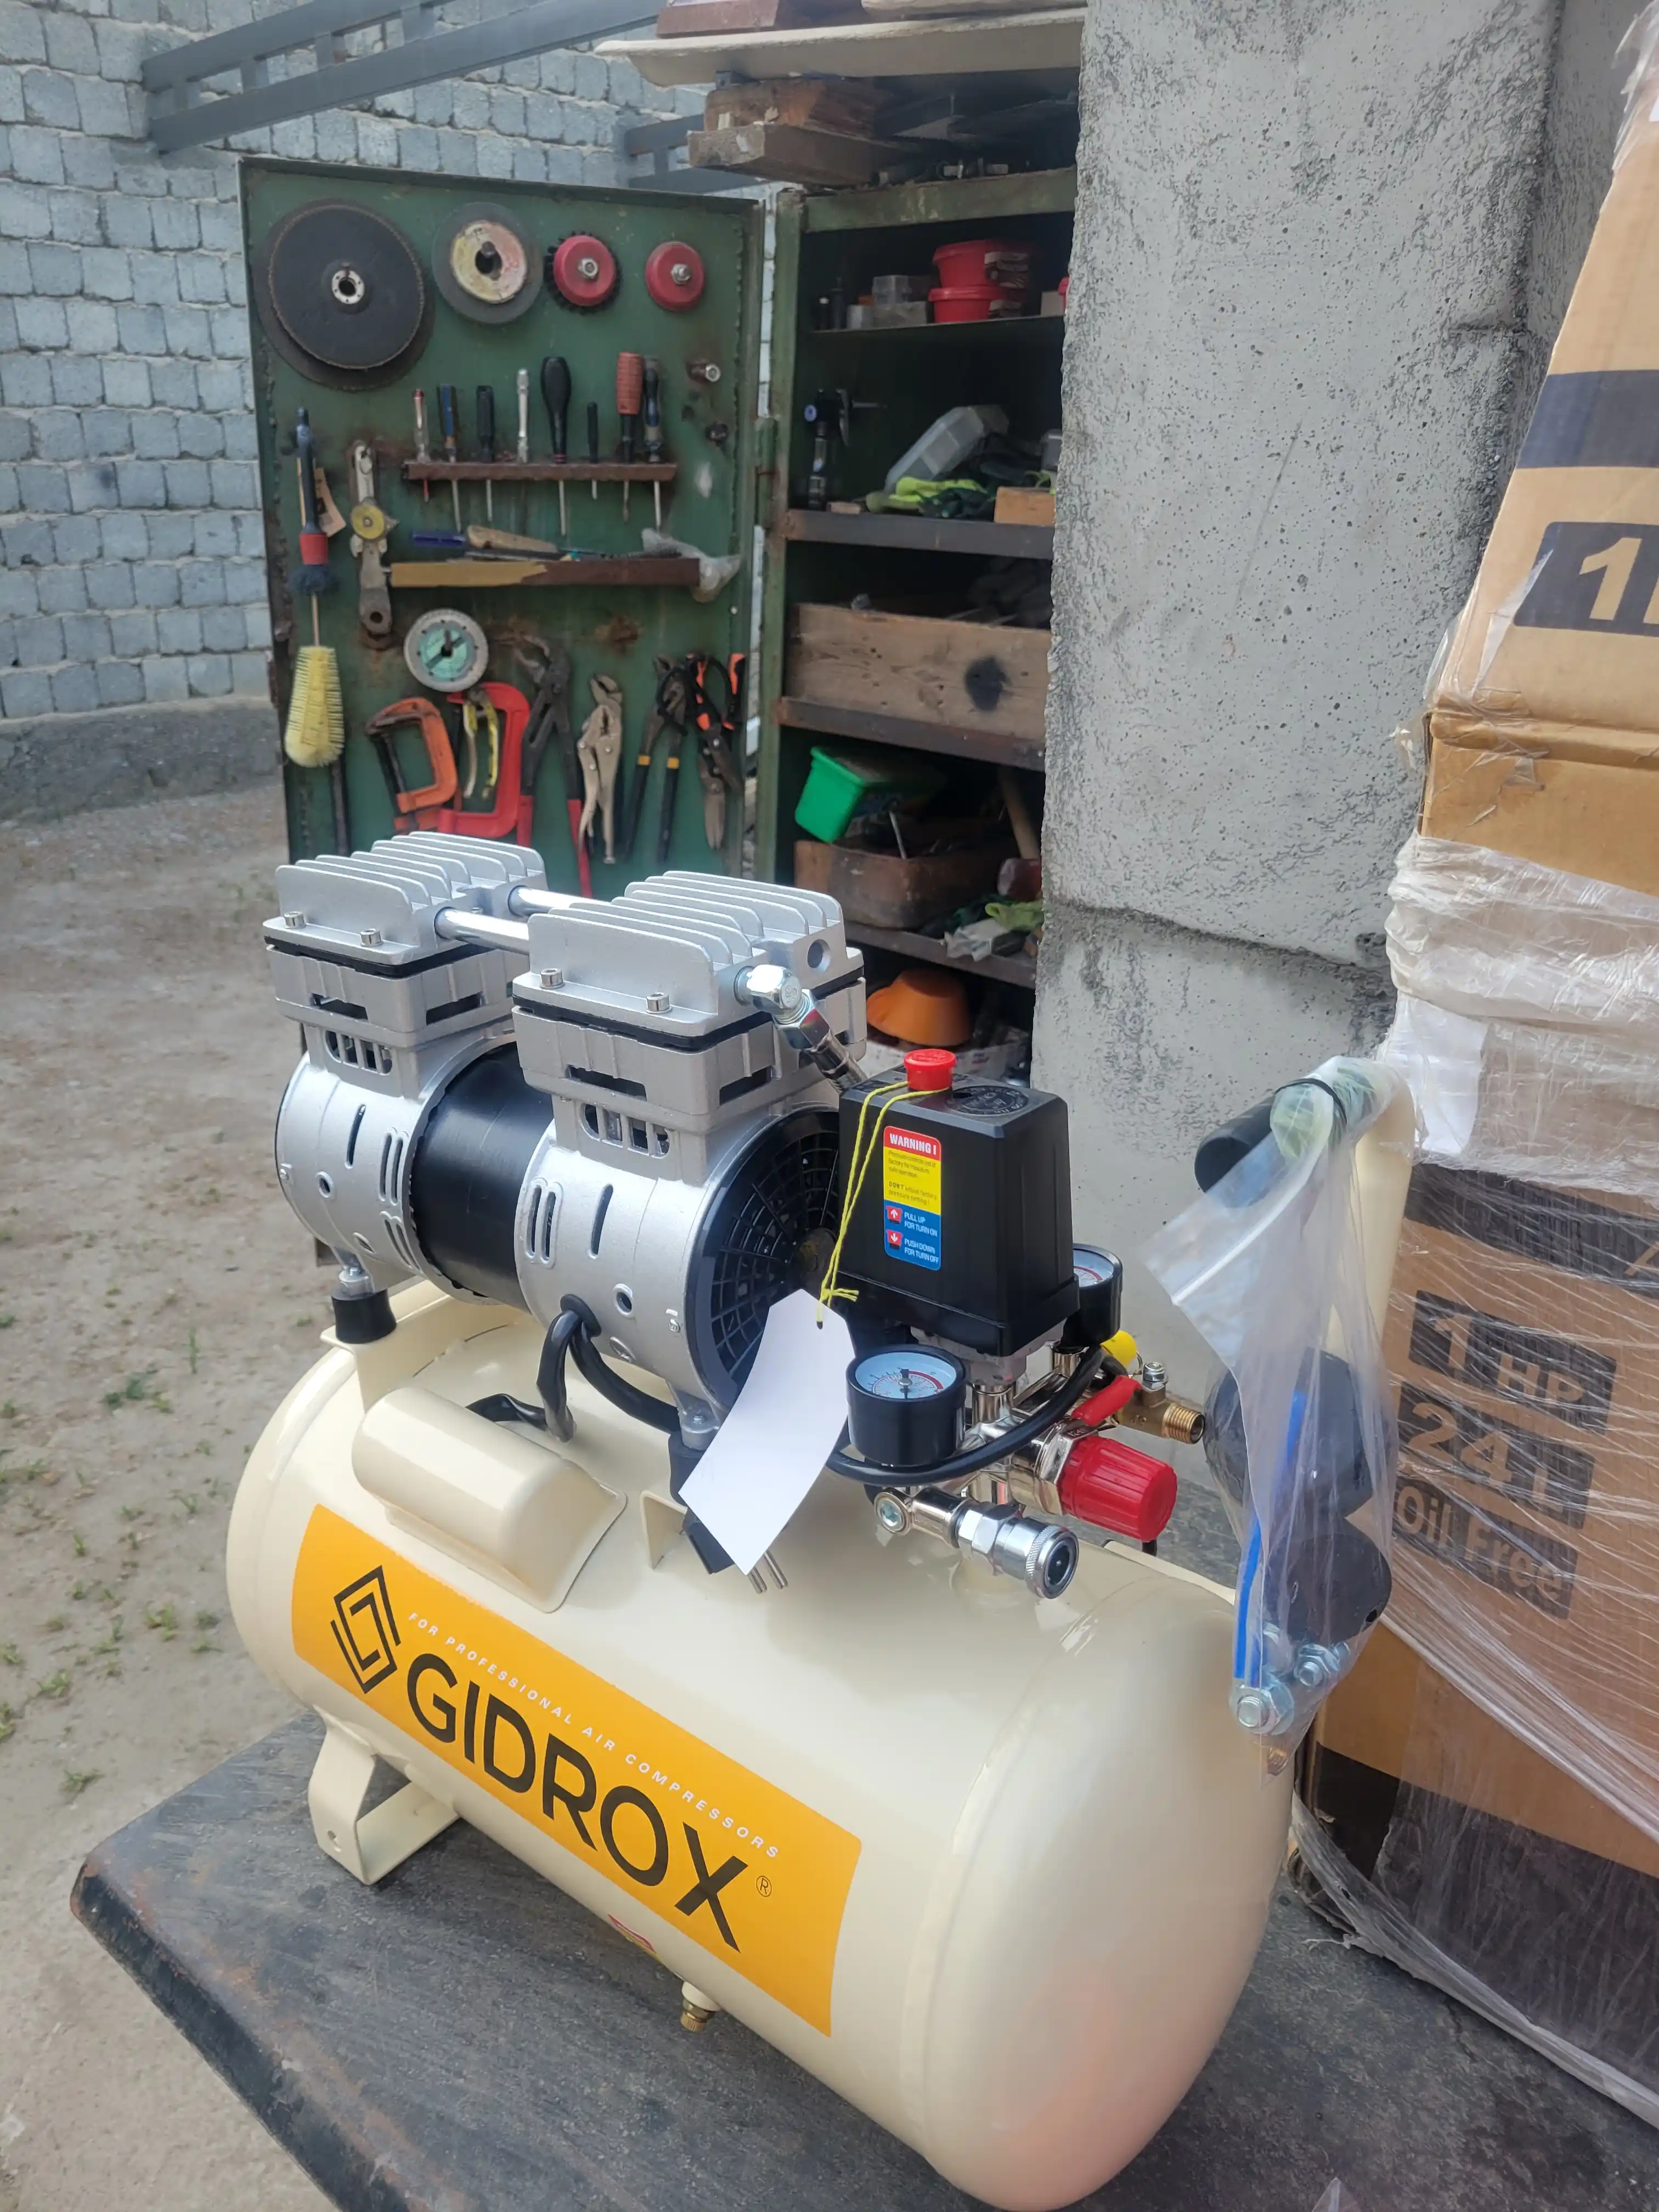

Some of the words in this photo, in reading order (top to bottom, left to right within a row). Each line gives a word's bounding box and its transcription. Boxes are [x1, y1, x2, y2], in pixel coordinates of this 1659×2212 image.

[1579, 537, 1643, 621] 1
[889, 1132, 932, 1154] WARNING
[904, 1211, 917, 1222] PULL
[917, 1215, 926, 1224] UP
[904, 1220, 915, 1231] FOR
[915, 1224, 929, 1235] TURN
[929, 1228, 938, 1237] ON
[904, 1238, 918, 1249] PUSH
[919, 1242, 935, 1254] DOWN
[904, 1246, 915, 1257] FOR
[915, 1250, 929, 1261] TURN
[929, 1255, 939, 1264] OFF
[1434, 1314, 1472, 1370] 1
[1497, 1351, 1584, 1404] HP
[1396, 1485, 1452, 1549] Oil
[1464, 1514, 1563, 1600] Free
[409, 1612, 439, 1636] FOR
[445, 1636, 572, 1724] PROFESSIONAL
[582, 1726, 616, 1751] AIR
[625, 1753, 778, 1858] COMPRESSORS
[407, 1653, 749, 1954] GIDROX
